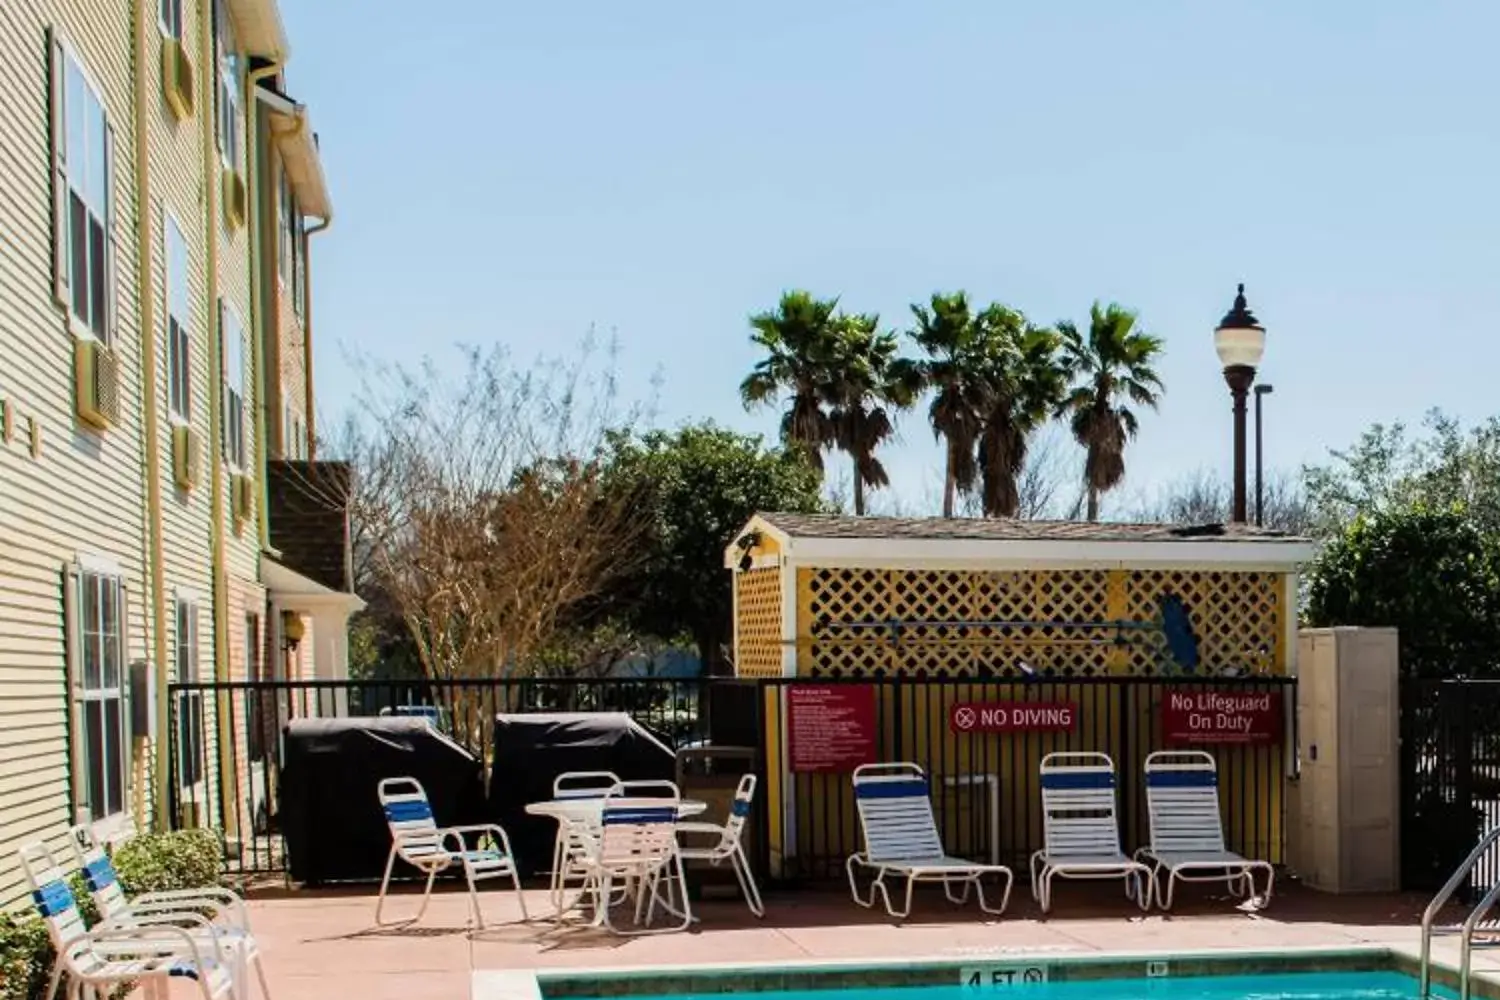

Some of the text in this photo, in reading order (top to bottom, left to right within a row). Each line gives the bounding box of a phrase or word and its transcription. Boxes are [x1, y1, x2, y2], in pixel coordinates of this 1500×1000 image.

[1171, 693, 1270, 714] No Lifeguard
[981, 709, 1071, 725] NO DIVING
[1189, 713, 1253, 733] On Duty
[992, 969, 1017, 985] FT
